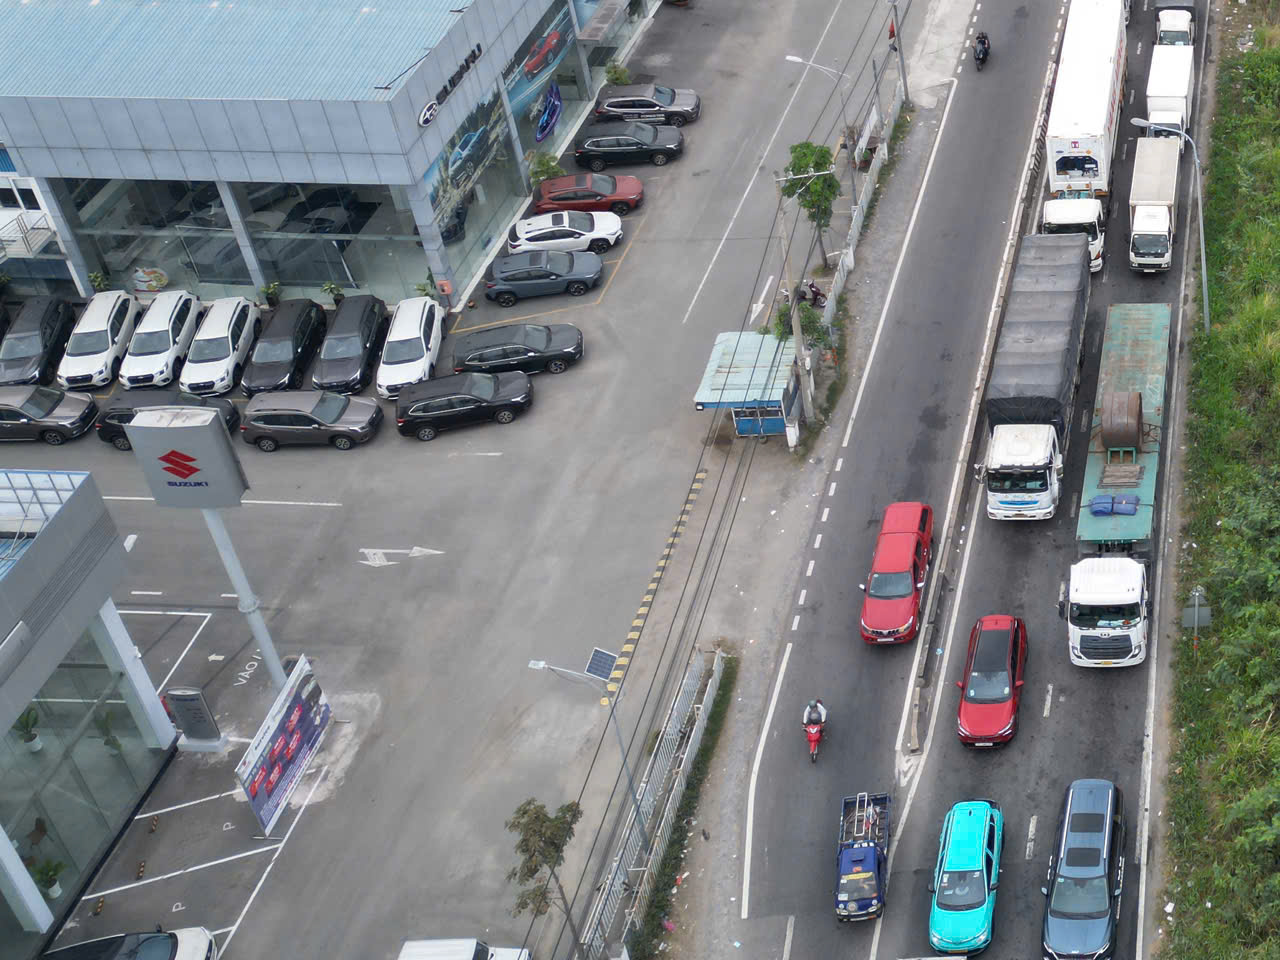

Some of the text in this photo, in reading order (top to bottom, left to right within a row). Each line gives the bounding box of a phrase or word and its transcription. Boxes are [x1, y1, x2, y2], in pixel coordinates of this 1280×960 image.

[436, 42, 483, 106] SUBARU
[222, 822, 235, 831] P
[172, 902, 186, 913] P
